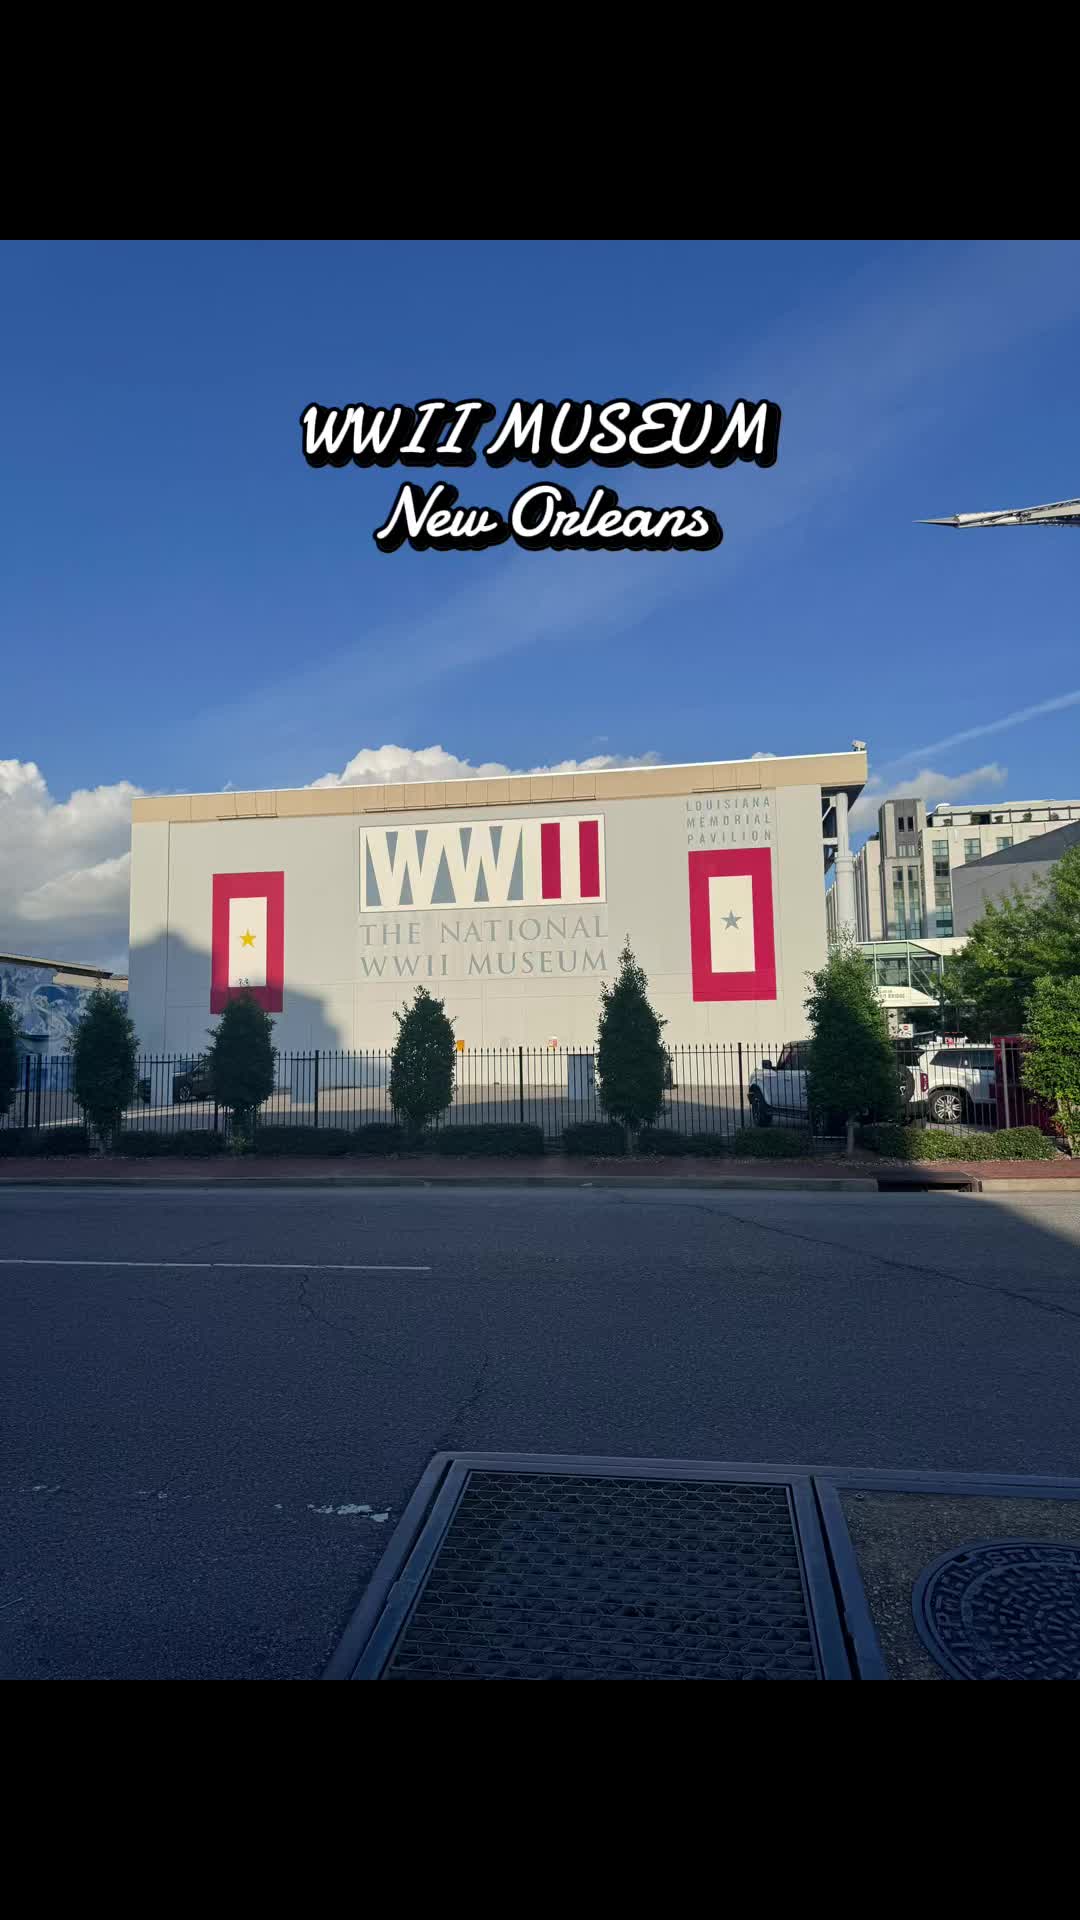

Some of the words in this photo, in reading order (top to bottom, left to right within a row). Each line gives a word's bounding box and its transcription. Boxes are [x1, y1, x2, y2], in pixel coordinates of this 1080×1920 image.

[687, 797, 769, 811] LOUISIANA
[687, 813, 772, 828] MEMORIAL
[687, 830, 771, 844] PAVILION
[365, 820, 600, 906] WWII
[360, 922, 421, 946] THE
[441, 915, 608, 943] NATIONAL
[361, 954, 449, 977] WWII
[468, 948, 608, 975] MUSEUM
